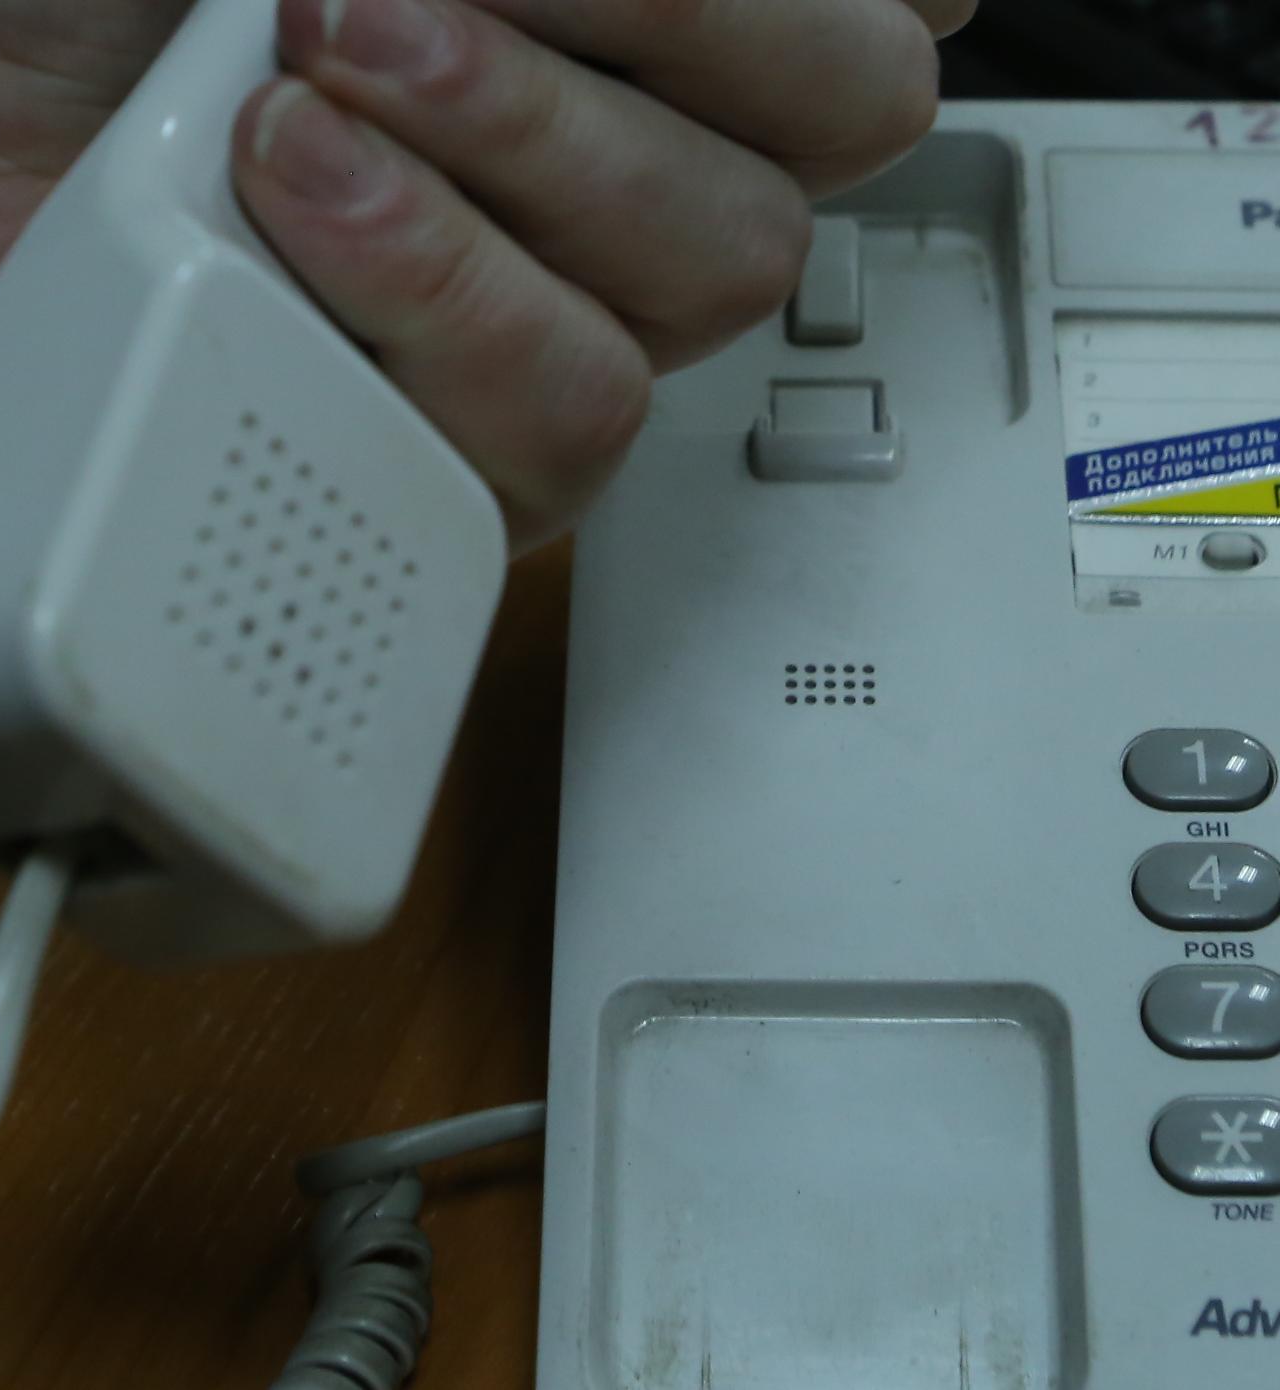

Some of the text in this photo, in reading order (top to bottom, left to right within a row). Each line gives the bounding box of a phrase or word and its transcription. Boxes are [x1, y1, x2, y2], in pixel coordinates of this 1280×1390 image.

[1087, 448, 1275, 492] подключения
[1153, 544, 1190, 561] M1
[1182, 739, 1208, 785] 1
[1186, 821, 1231, 837] GHI
[1188, 854, 1228, 902] 4
[1184, 941, 1256, 959] PQRS
[1200, 981, 1241, 1033] 7
[1212, 1203, 1274, 1222] TONE
